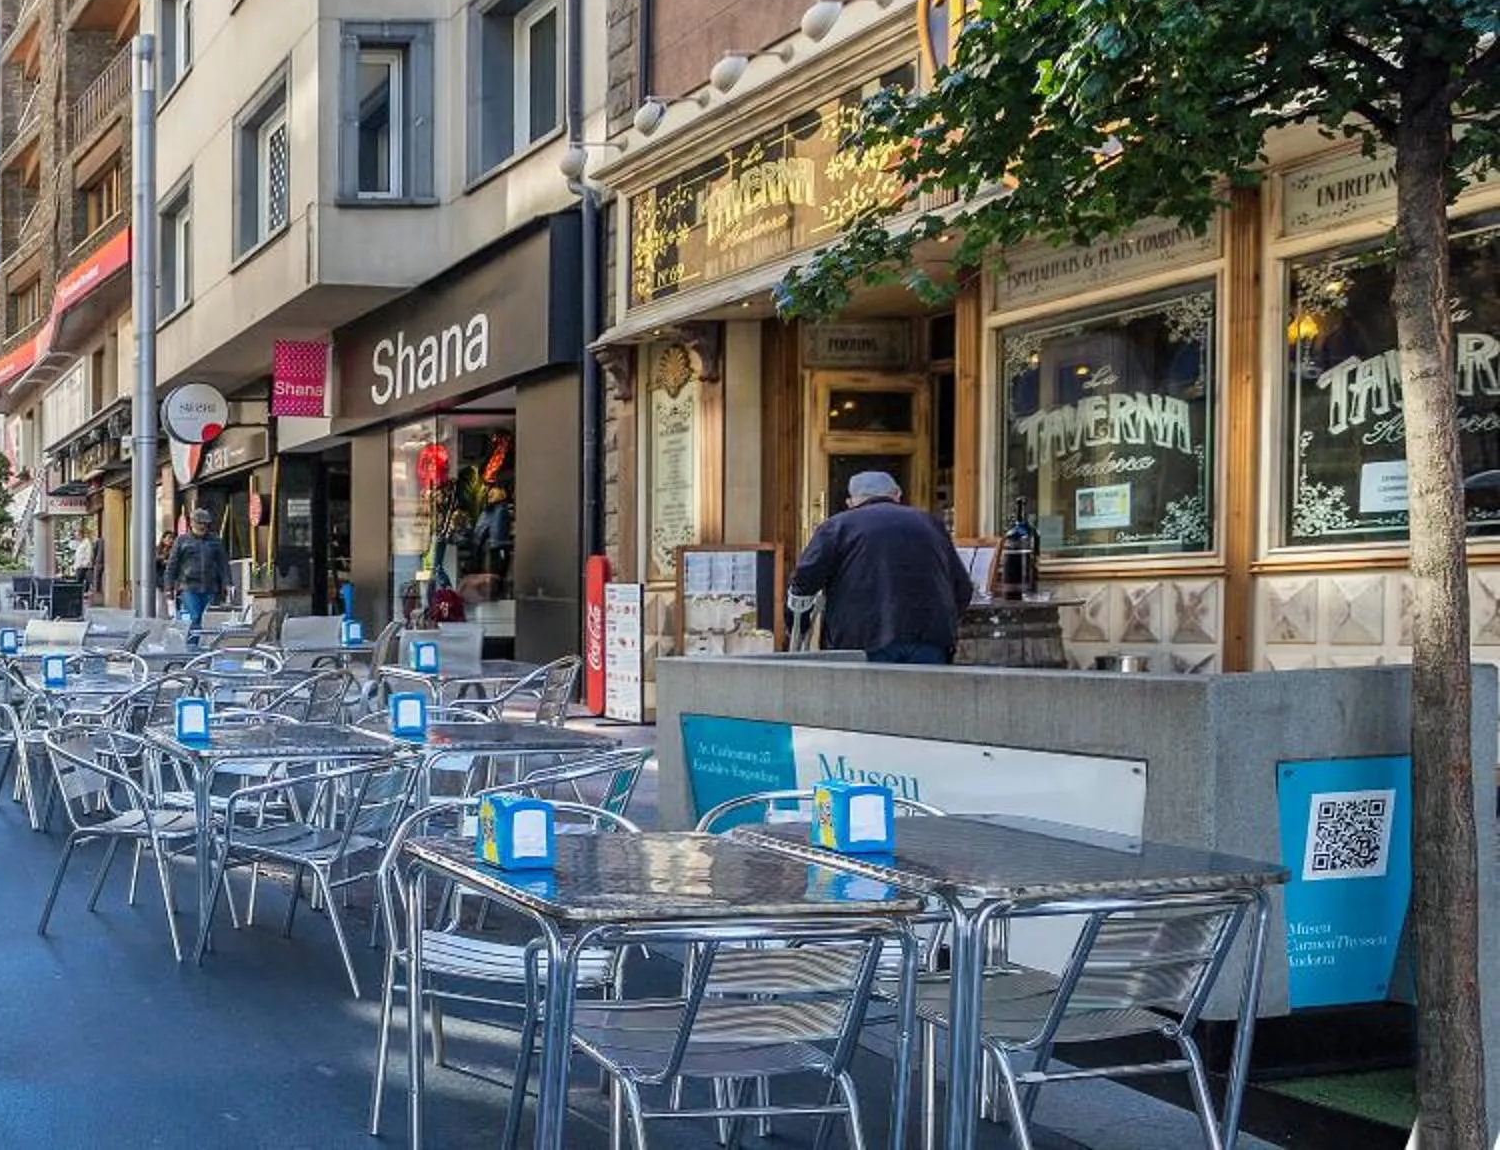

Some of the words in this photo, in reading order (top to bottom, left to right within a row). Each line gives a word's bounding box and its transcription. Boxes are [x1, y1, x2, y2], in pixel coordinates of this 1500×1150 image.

[371, 313, 489, 405] Shana
[274, 381, 323, 398] Shana
[1017, 391, 1192, 472] TAVERNA
[1288, 921, 1331, 936] Museu
